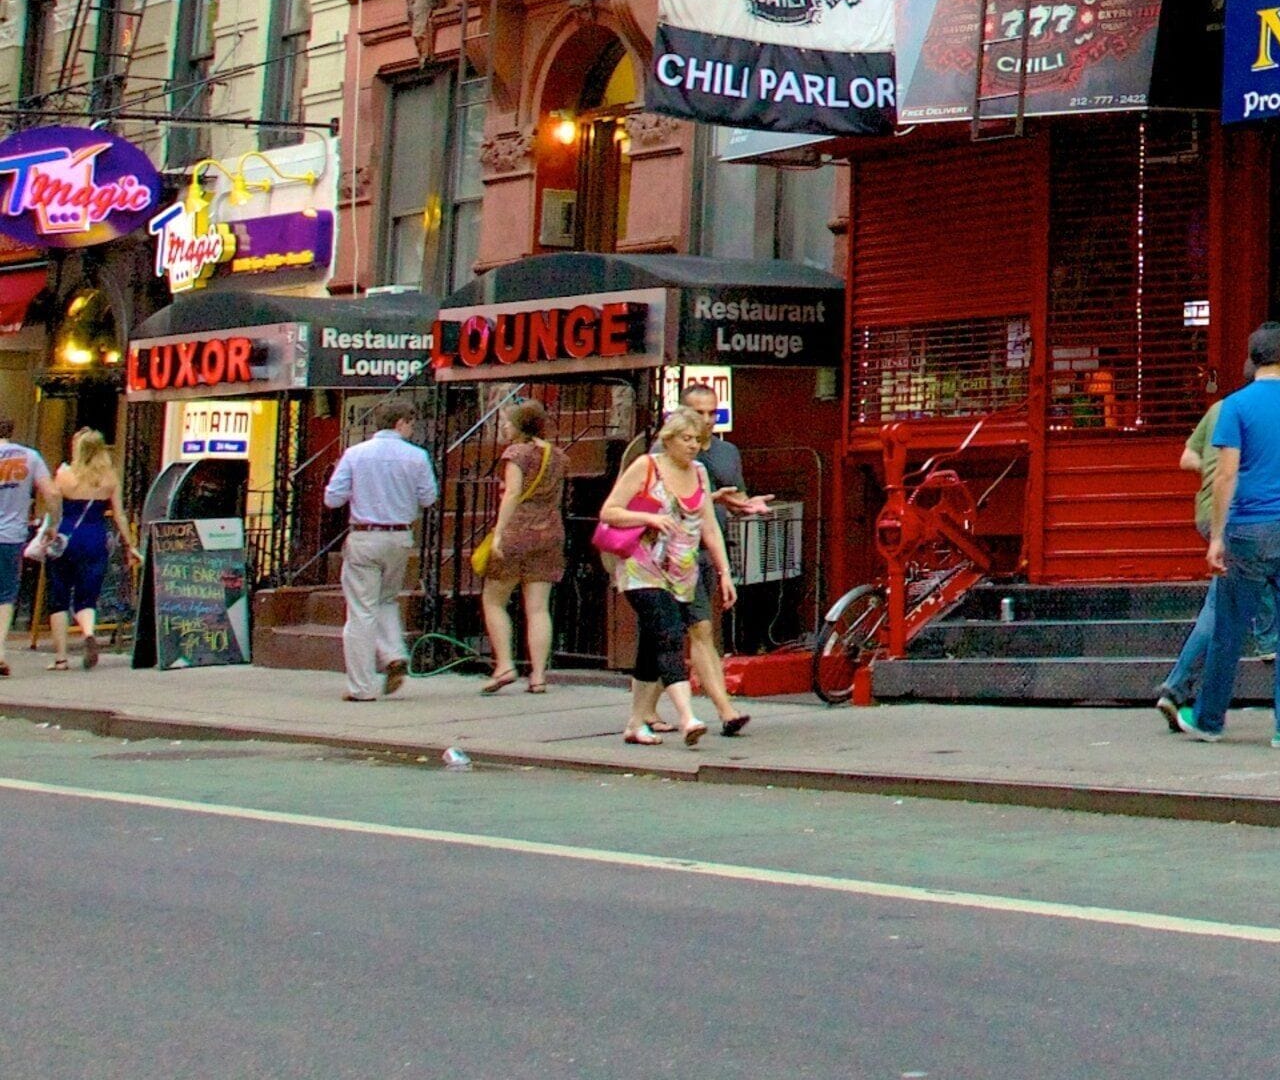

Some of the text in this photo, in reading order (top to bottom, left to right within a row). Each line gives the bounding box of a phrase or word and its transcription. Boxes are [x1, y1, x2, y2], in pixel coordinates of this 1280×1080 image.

[1001, 4, 1077, 38] 777
[997, 53, 1064, 74] CHILI
[657, 53, 896, 109] CHILI PARLOR
[695, 298, 826, 321] Restaurant
[322, 328, 434, 350] Restauran
[432, 302, 629, 368] LOUNGE
[716, 328, 803, 358] Lounge
[130, 337, 252, 390] LUXOR
[342, 355, 423, 380] Lounge
[210, 411, 249, 433] ATM
